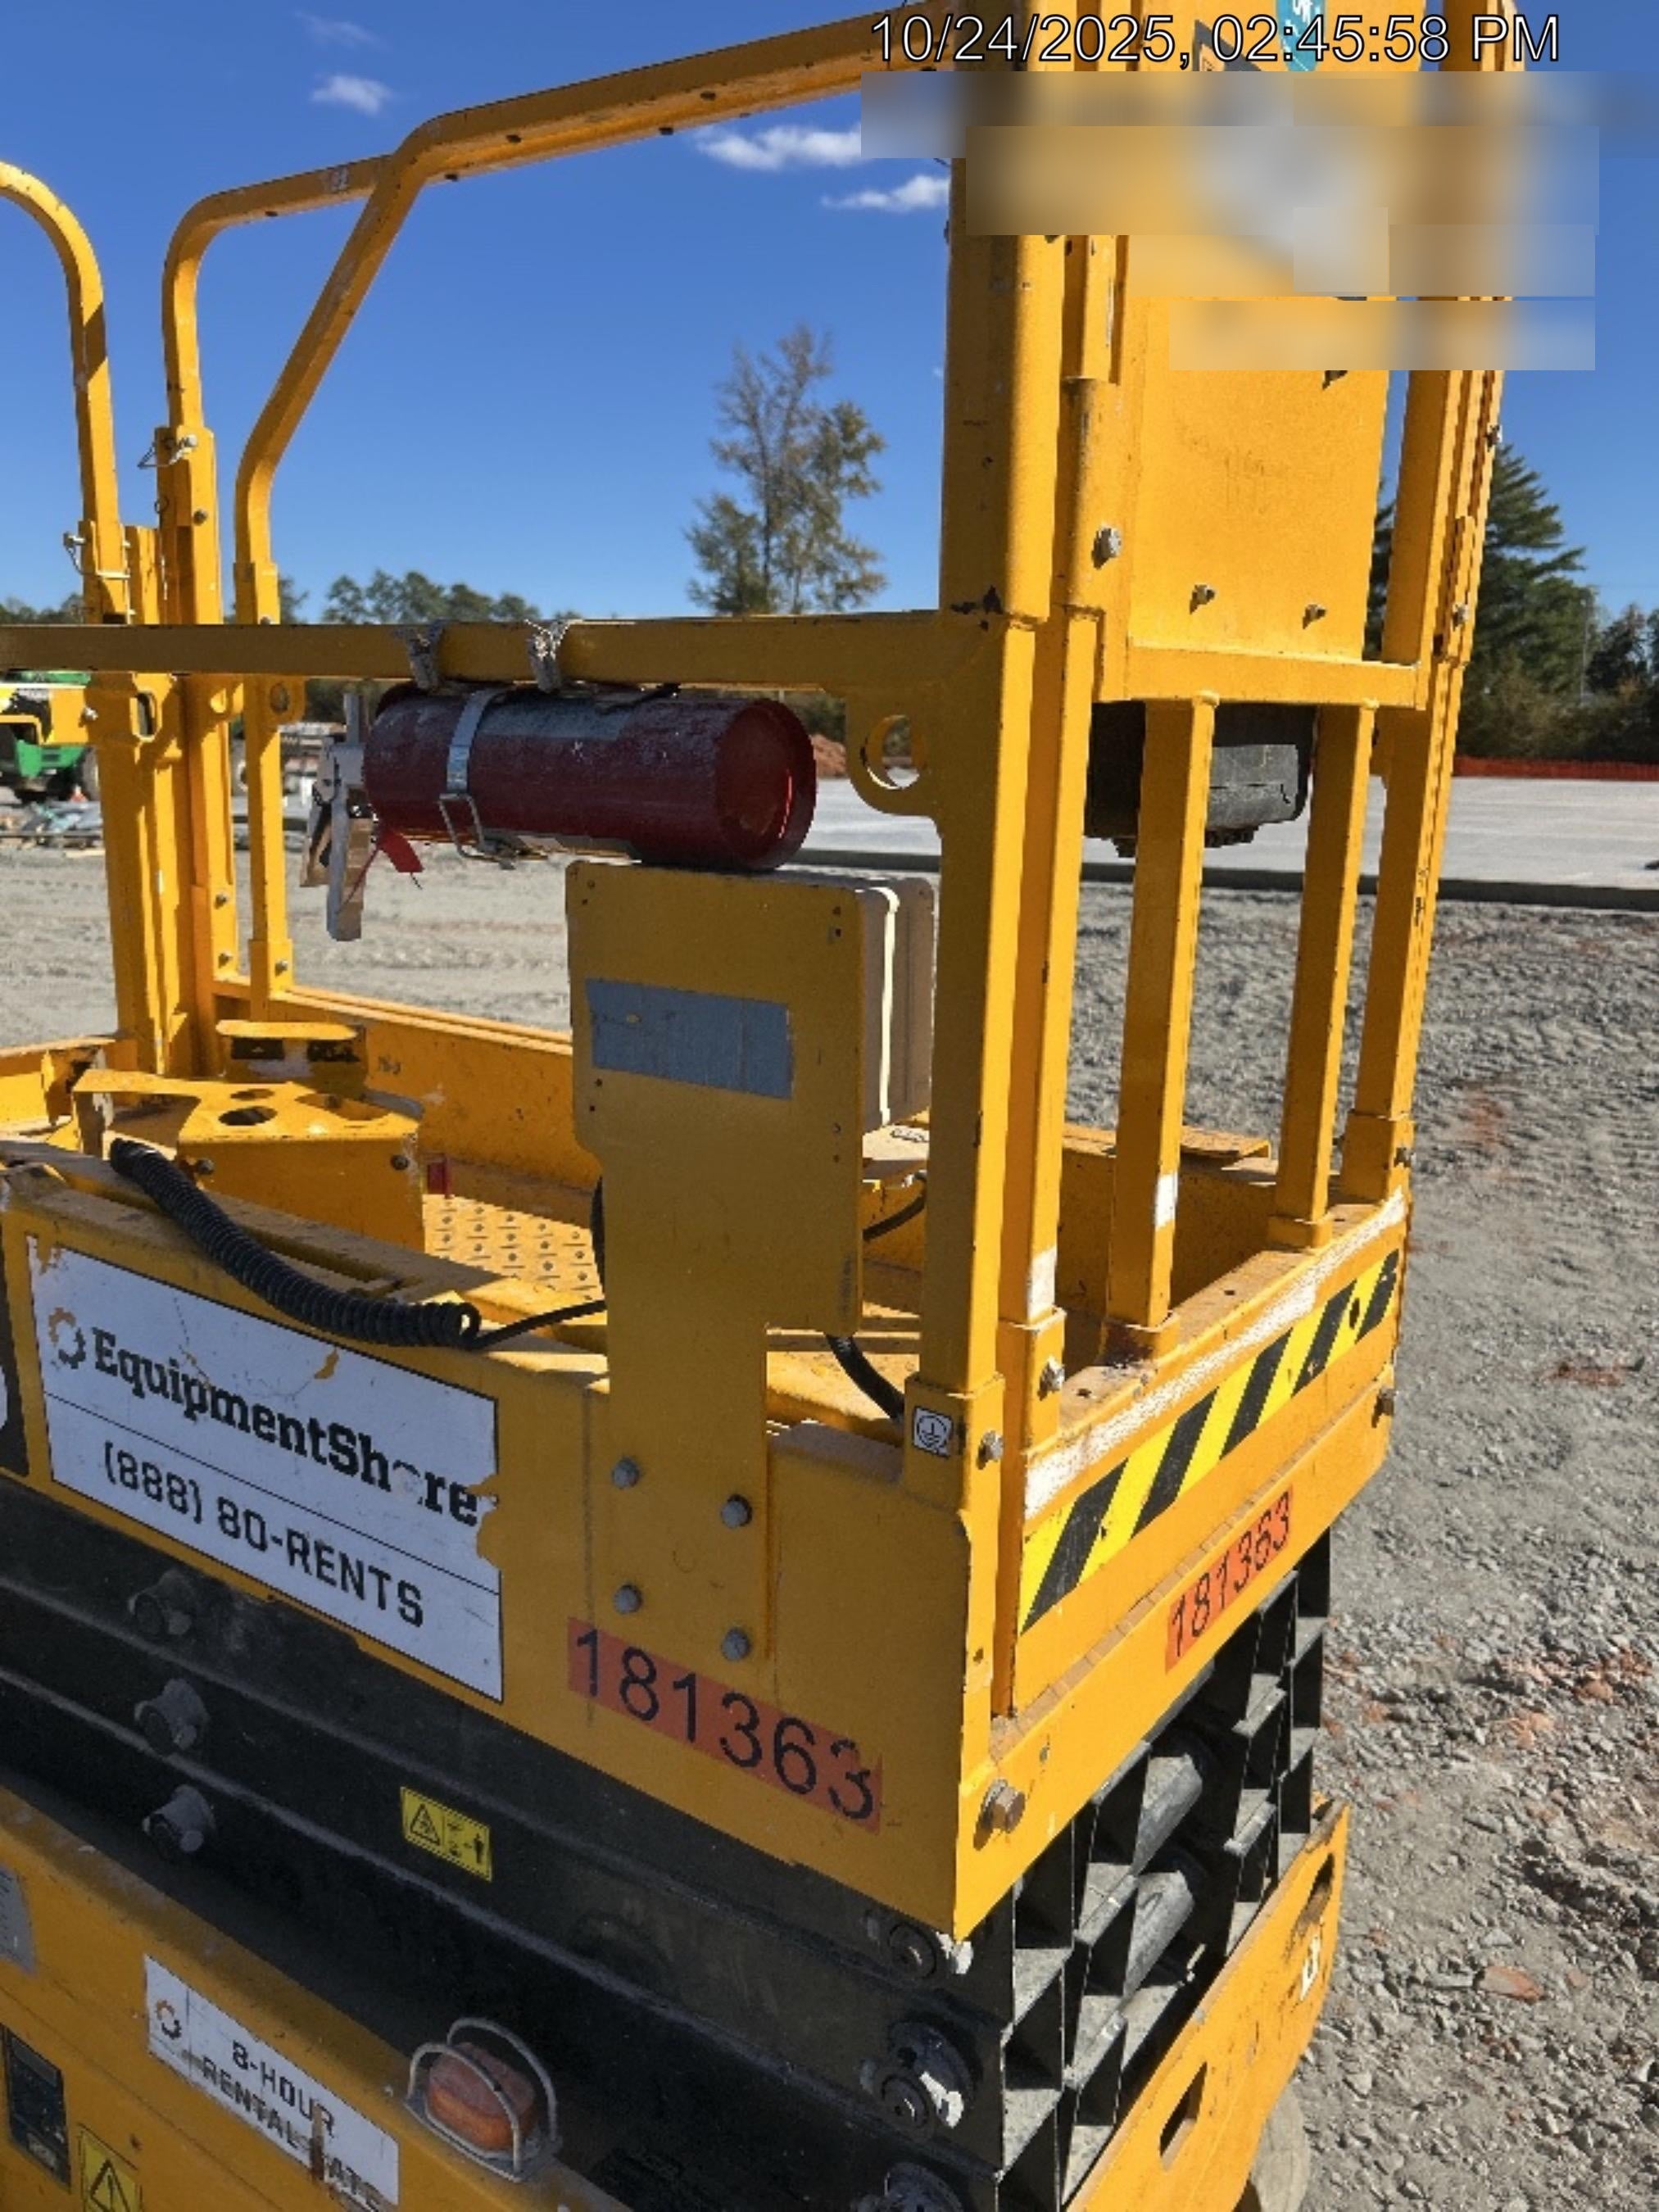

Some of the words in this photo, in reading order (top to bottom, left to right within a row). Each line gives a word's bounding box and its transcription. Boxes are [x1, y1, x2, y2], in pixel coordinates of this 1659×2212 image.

[92, 1326, 478, 1527] EquipmentShre
[104, 1440, 202, 1524] (888)
[217, 1495, 424, 1627] 80-RENTS
[576, 1629, 873, 1820] 181363
[202, 2055, 297, 2150] RENTAL
